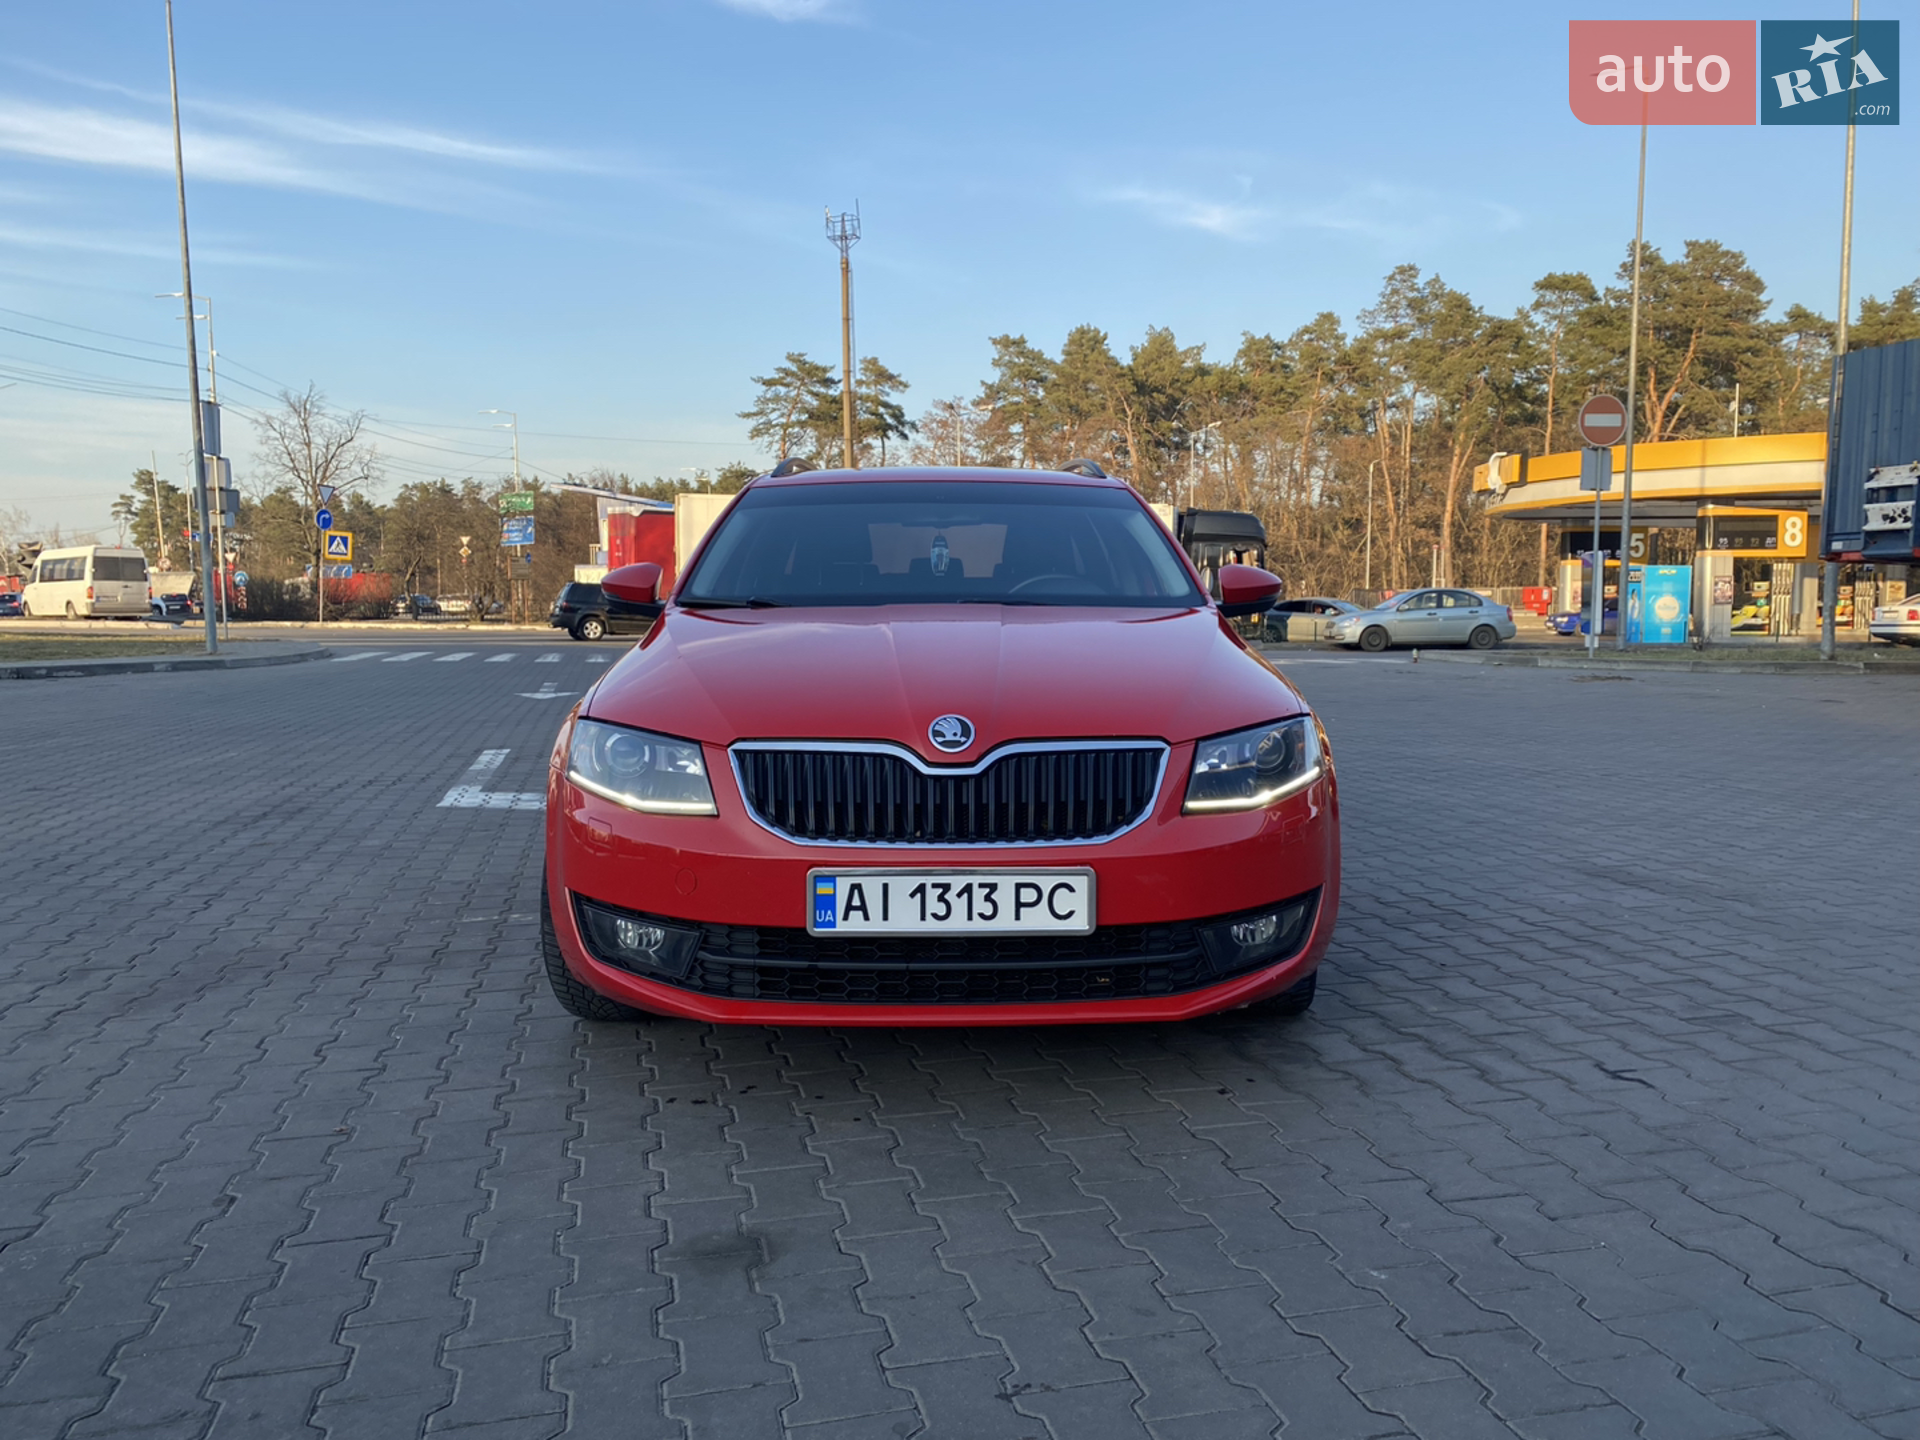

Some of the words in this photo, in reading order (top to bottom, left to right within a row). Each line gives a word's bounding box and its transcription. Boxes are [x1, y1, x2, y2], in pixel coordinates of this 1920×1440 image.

[1629, 532, 1646, 558] 5
[1783, 516, 1803, 548] 8
[816, 909, 835, 922] UA
[842, 882, 889, 922] AI
[908, 882, 999, 922] 1313
[1013, 882, 1077, 922] PC
